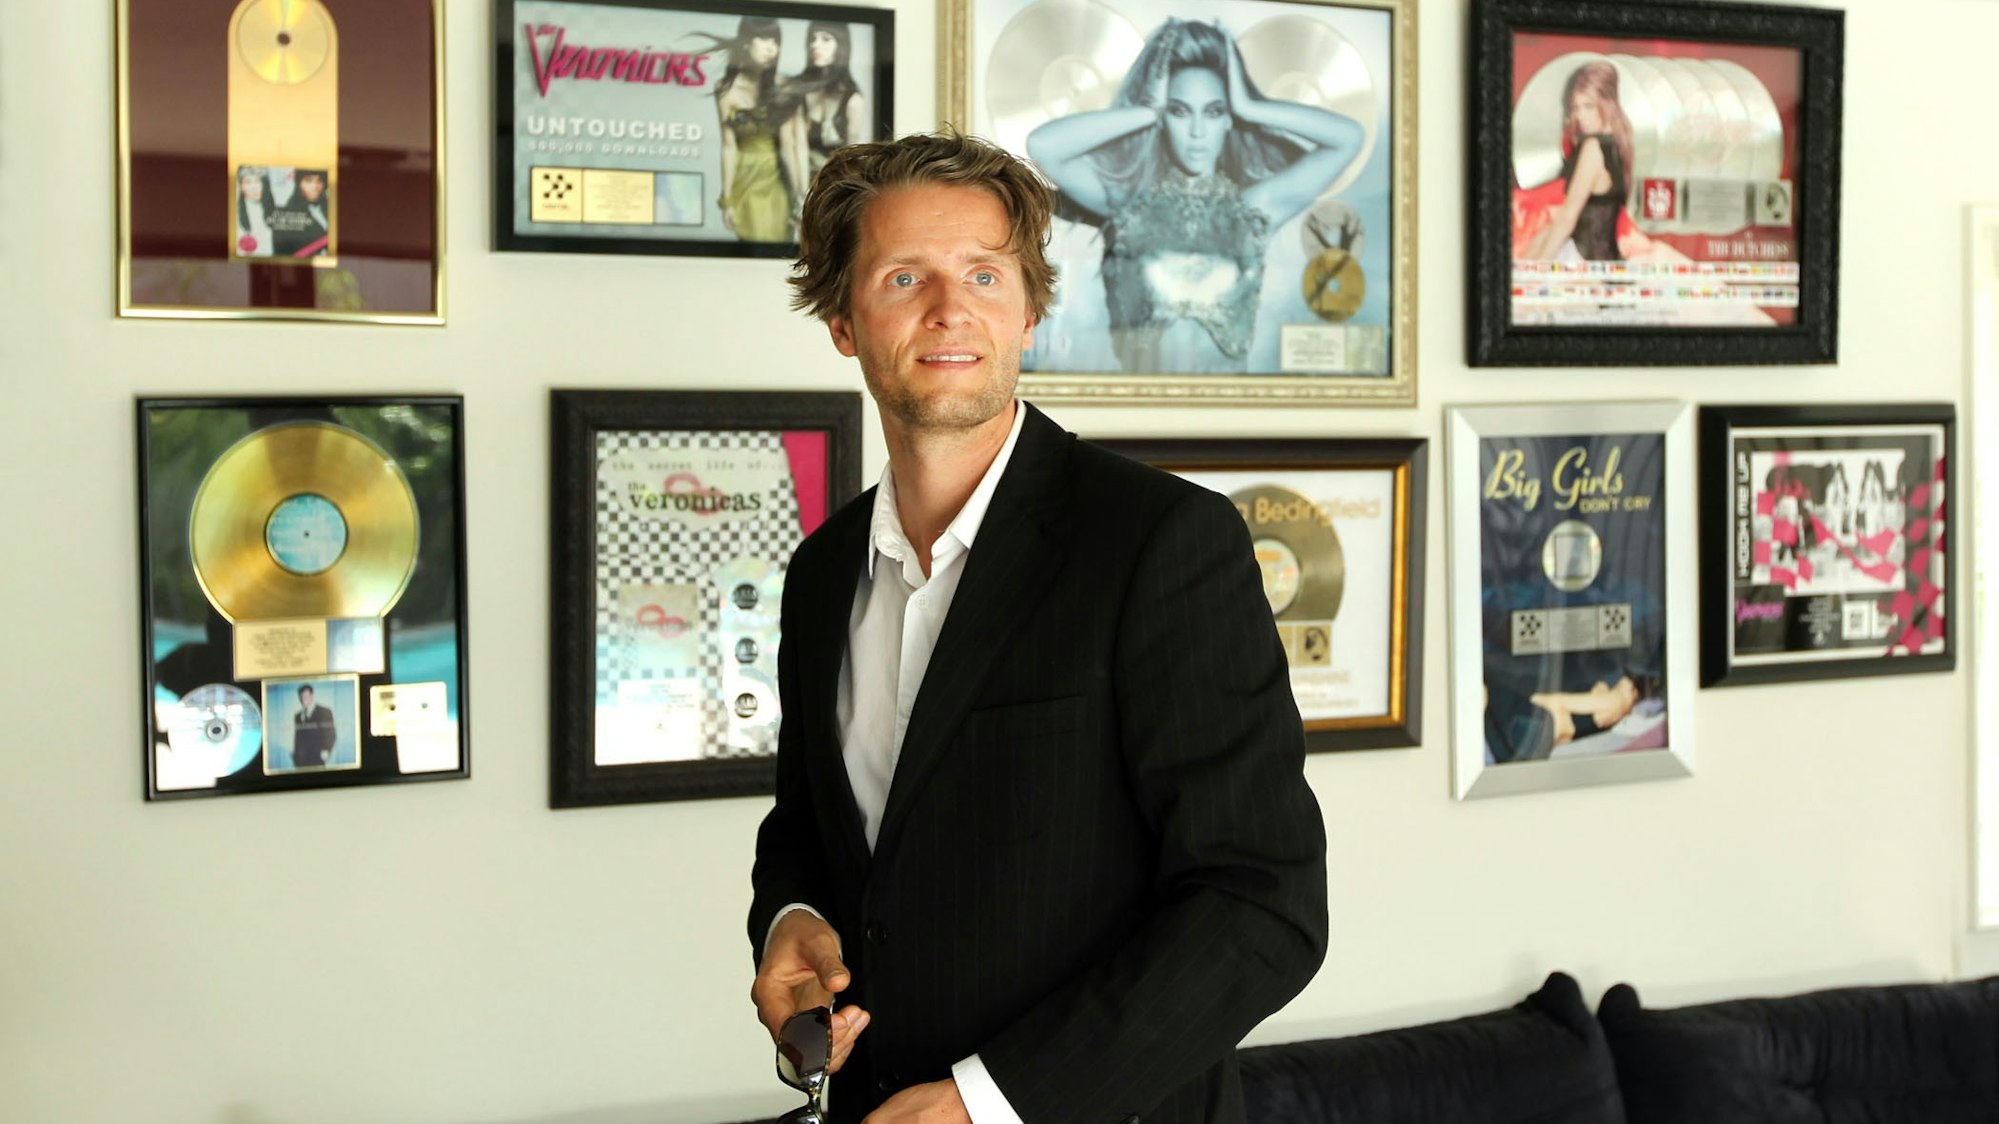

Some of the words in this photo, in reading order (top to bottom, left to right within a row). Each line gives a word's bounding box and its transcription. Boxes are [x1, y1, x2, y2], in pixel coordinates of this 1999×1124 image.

[527, 115, 703, 141] UNTOUCHED
[601, 143, 701, 158] DOWNLOADS
[612, 459, 634, 470] the
[648, 460, 693, 470] secret
[707, 460, 735, 470] life
[1737, 451, 1749, 483] UP
[628, 481, 646, 491] the
[1484, 448, 1541, 512] Big
[1552, 446, 1624, 510] Girls
[629, 486, 762, 512] veronicas
[1623, 495, 1653, 512] CRY
[1737, 485, 1749, 517] ME
[1737, 519, 1750, 577] HOOK
